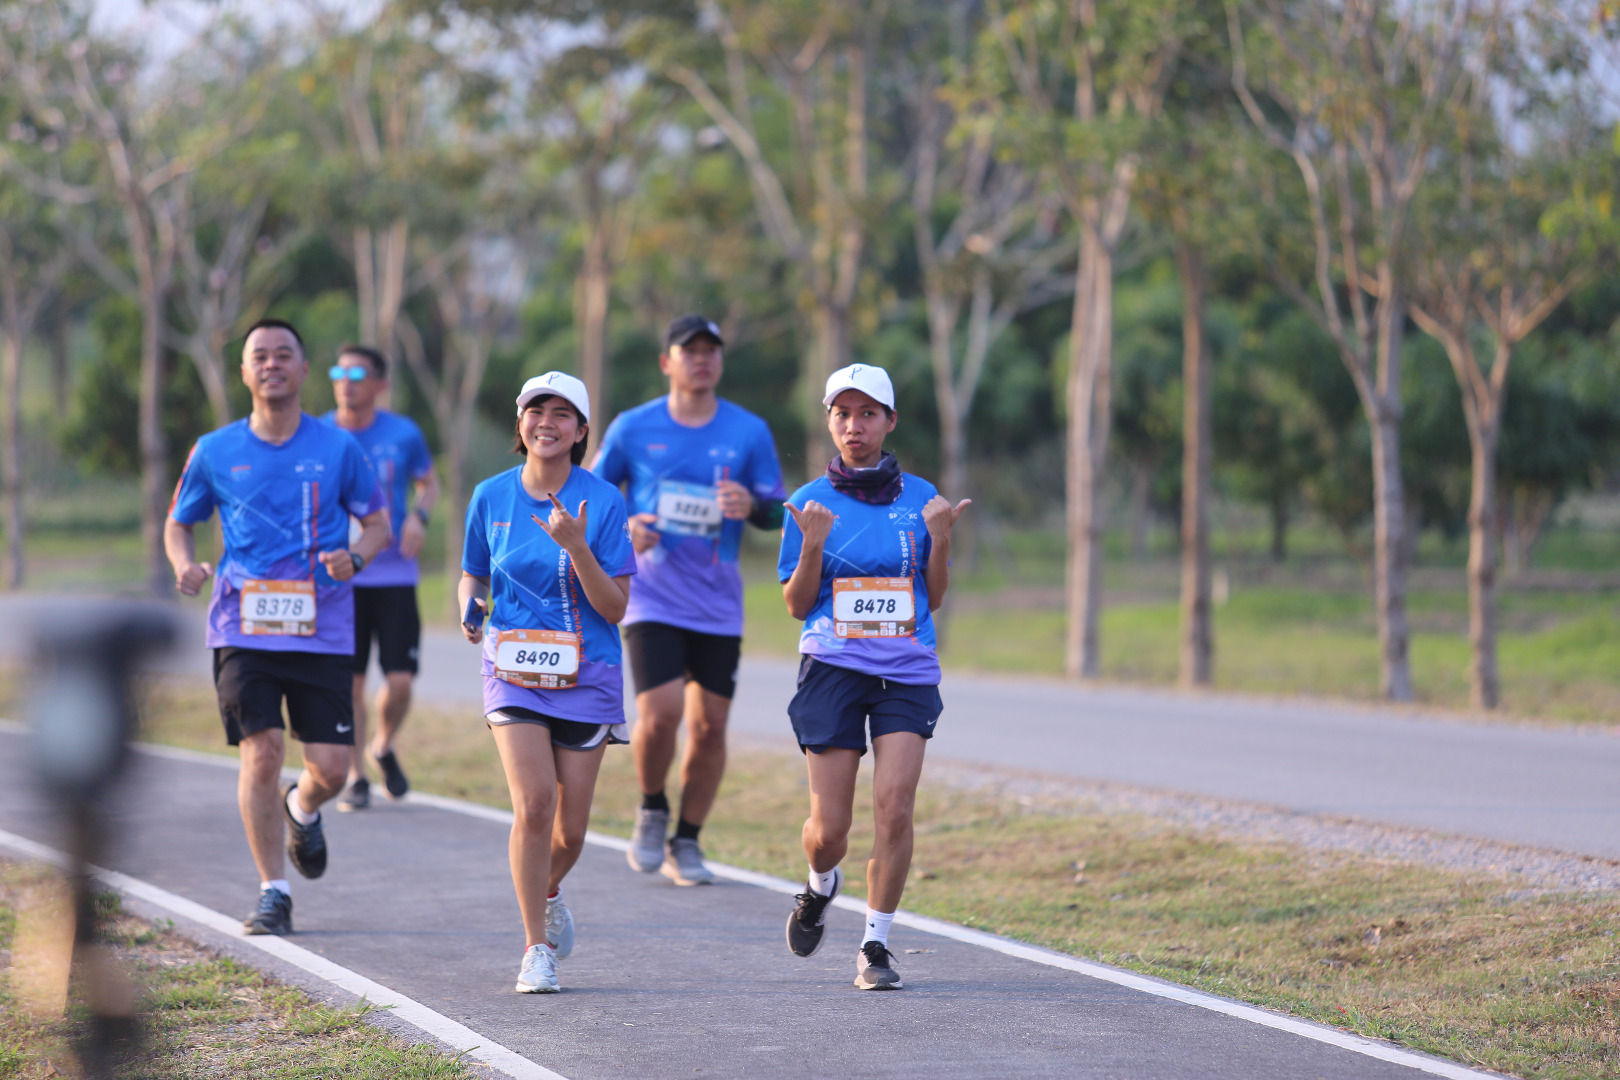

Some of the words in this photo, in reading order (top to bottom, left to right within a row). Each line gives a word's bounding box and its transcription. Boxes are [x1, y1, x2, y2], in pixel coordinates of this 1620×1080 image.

[898, 530, 909, 558] CROSS
[558, 548, 567, 577] CROSS
[256, 597, 304, 616] 8378
[558, 578, 570, 613] COUNTRY
[853, 598, 896, 614] 8478
[515, 649, 560, 666] 8490
